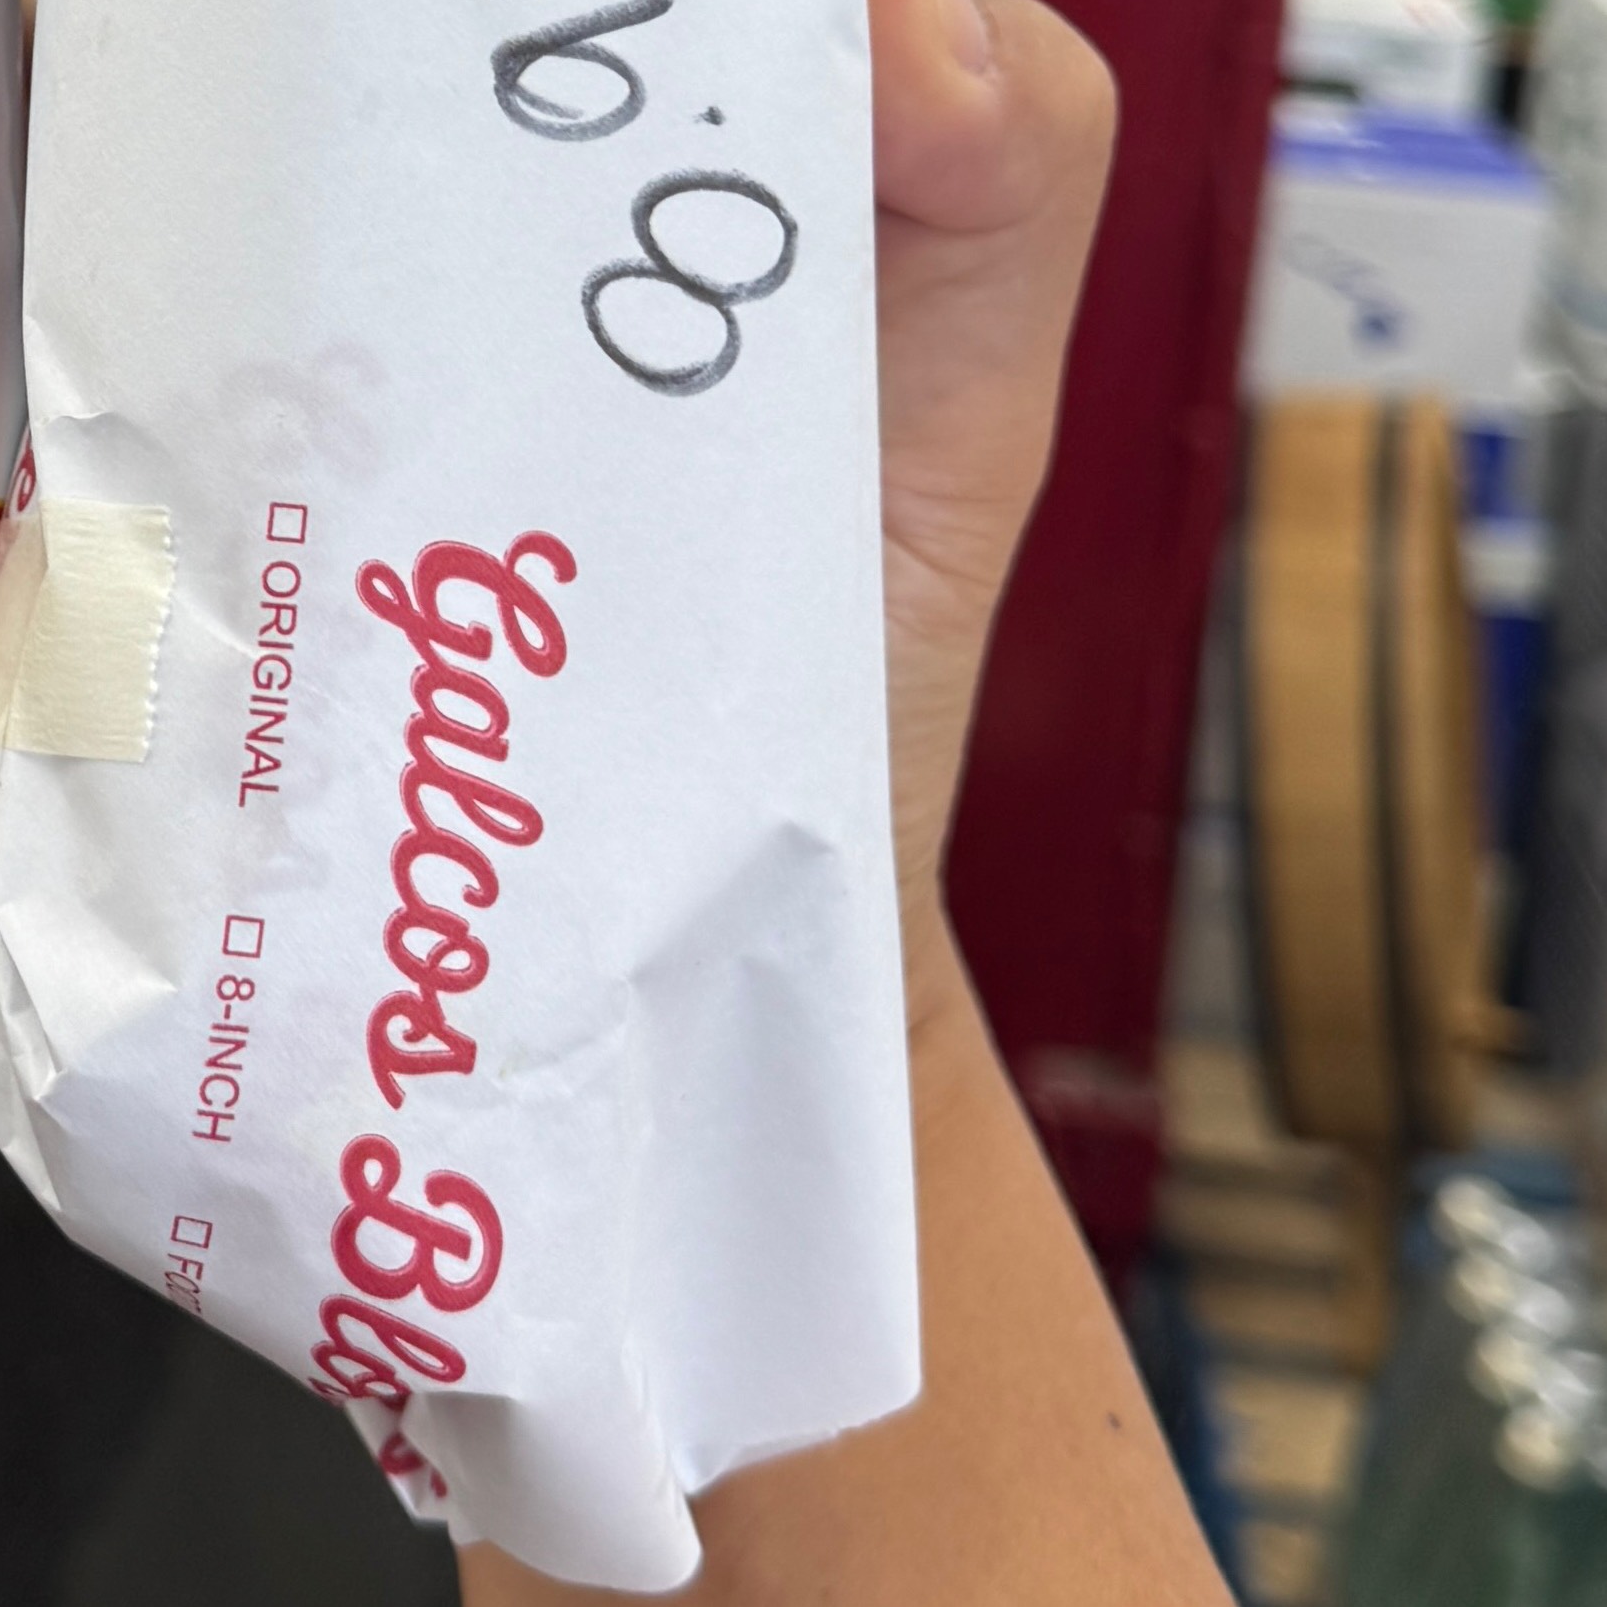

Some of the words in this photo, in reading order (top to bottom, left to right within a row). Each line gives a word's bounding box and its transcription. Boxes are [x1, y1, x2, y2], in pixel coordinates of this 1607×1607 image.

[238, 557, 304, 809] ORIGINAL
[354, 530, 578, 1112] Galcos
[192, 973, 257, 1145] 8-INCH
